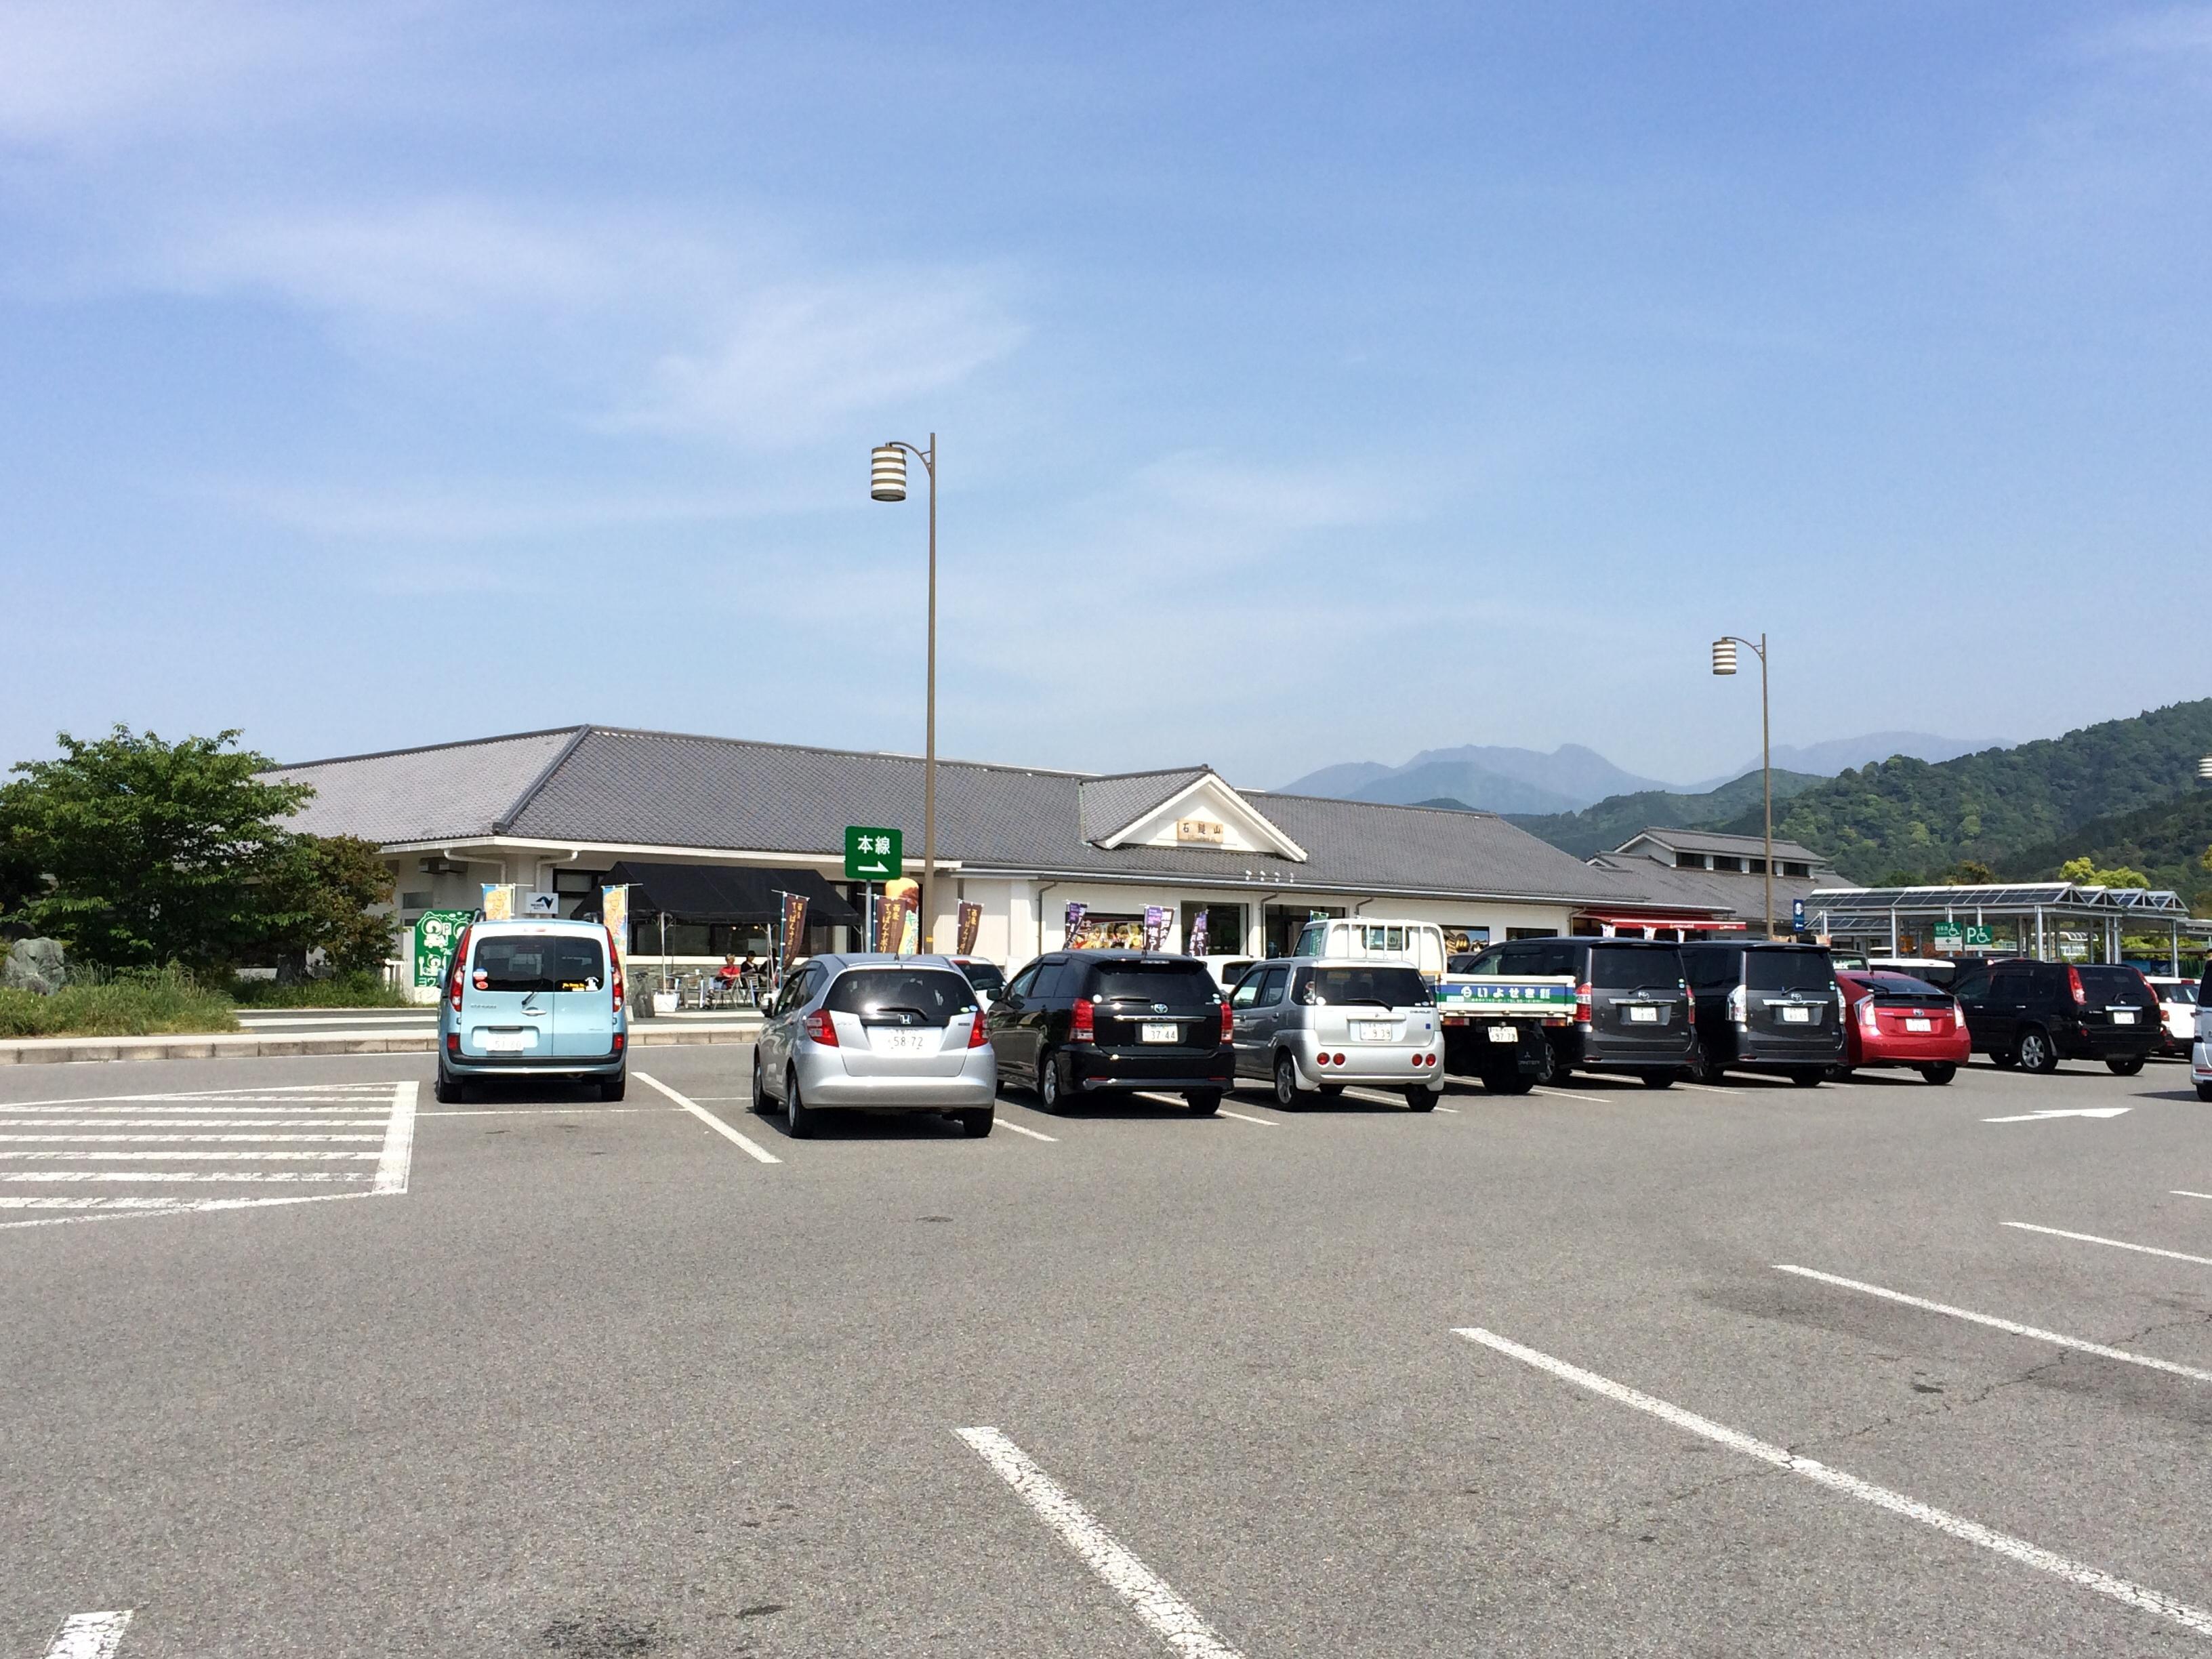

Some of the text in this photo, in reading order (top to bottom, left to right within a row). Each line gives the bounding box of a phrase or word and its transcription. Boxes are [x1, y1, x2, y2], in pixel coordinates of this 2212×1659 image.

[857, 834, 890, 855] 本線
[444, 924, 451, 934] P
[1967, 927, 1977, 943] P
